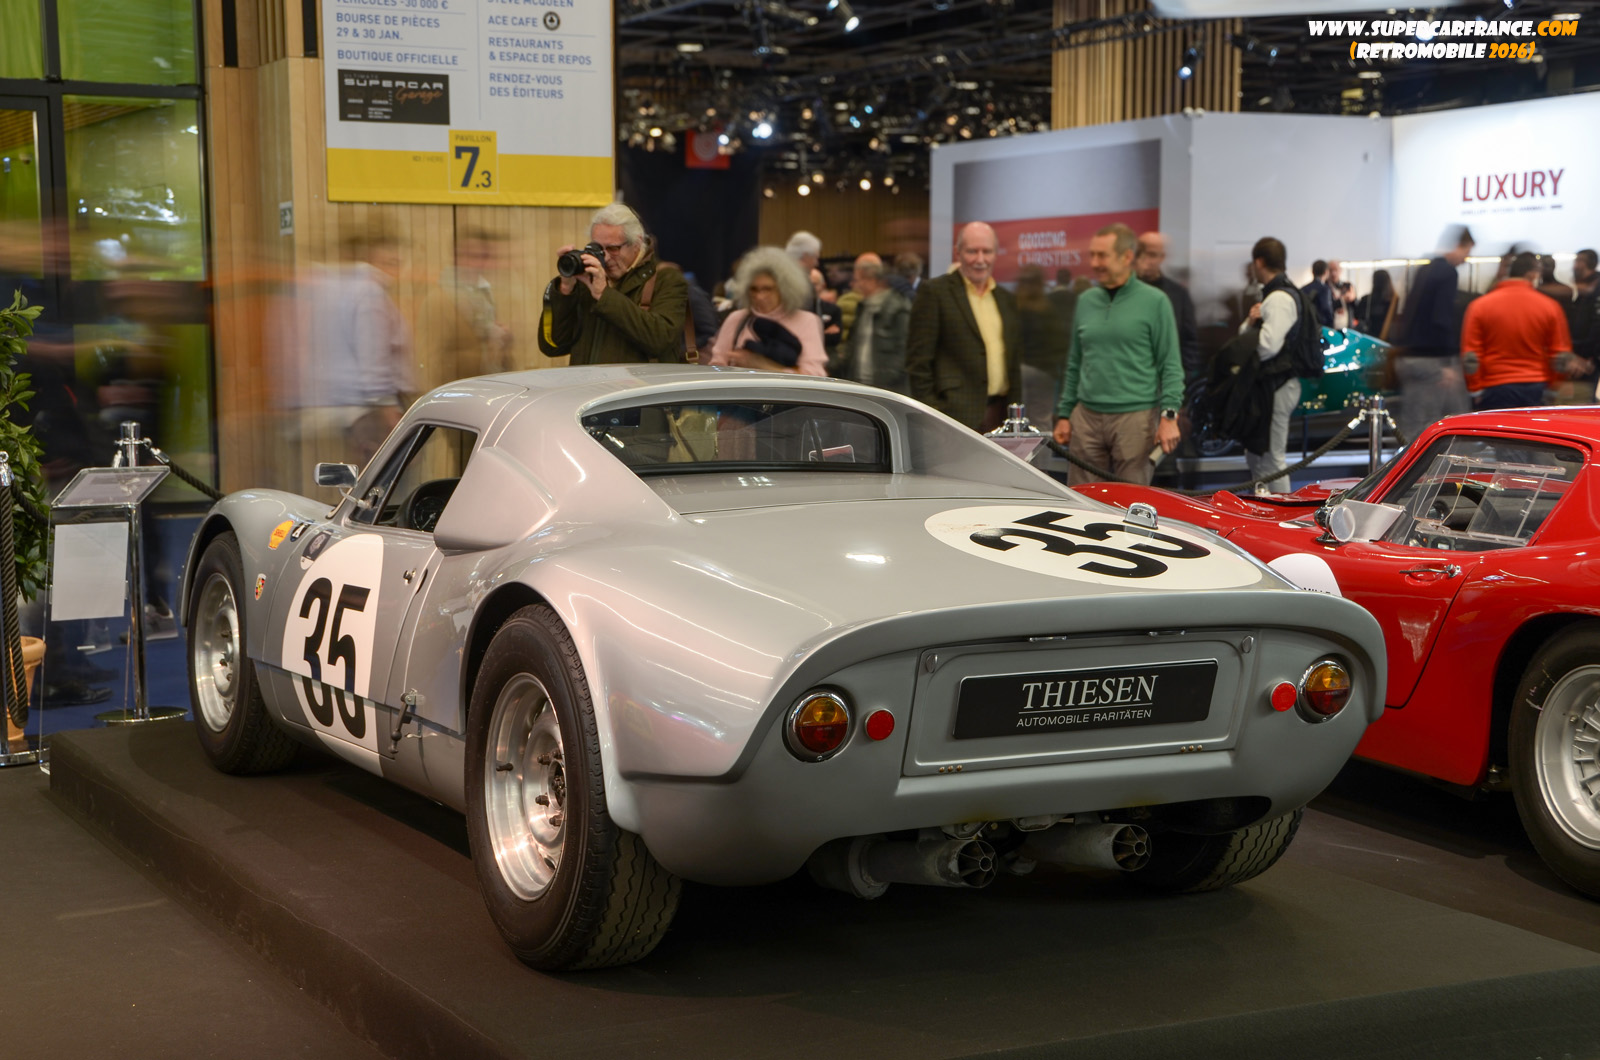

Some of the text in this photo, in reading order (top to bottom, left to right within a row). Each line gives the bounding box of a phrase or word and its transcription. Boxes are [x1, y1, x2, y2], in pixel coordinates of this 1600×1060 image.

[420, 0, 438, 8] 000
[441, 0, 449, 10] €
[336, 12, 440, 28] BOURSE DE PIÈCES
[488, 15, 538, 27] ACE CAFE
[336, 27, 403, 40] 29 & 30 JAN.
[488, 37, 564, 50] RESTAURANTS
[337, 49, 459, 65] BOUTIQUE OFFICIELLE
[489, 51, 592, 65] & ESPACE DE REPOS
[344, 78, 444, 90] SUPERCAR
[489, 72, 563, 85] RENDEZ-VOUS
[489, 86, 564, 99] DES ÉDITEURS
[455, 134, 492, 143] PAVILLON
[455, 146, 492, 188] 7.3
[1462, 168, 1564, 202] LUXURY
[969, 511, 1211, 579] 35
[298, 577, 371, 739] 35
[1022, 675, 1159, 709] THIESEN
[1016, 709, 1152, 728] AUTOMOBILE RARITÄTEN
